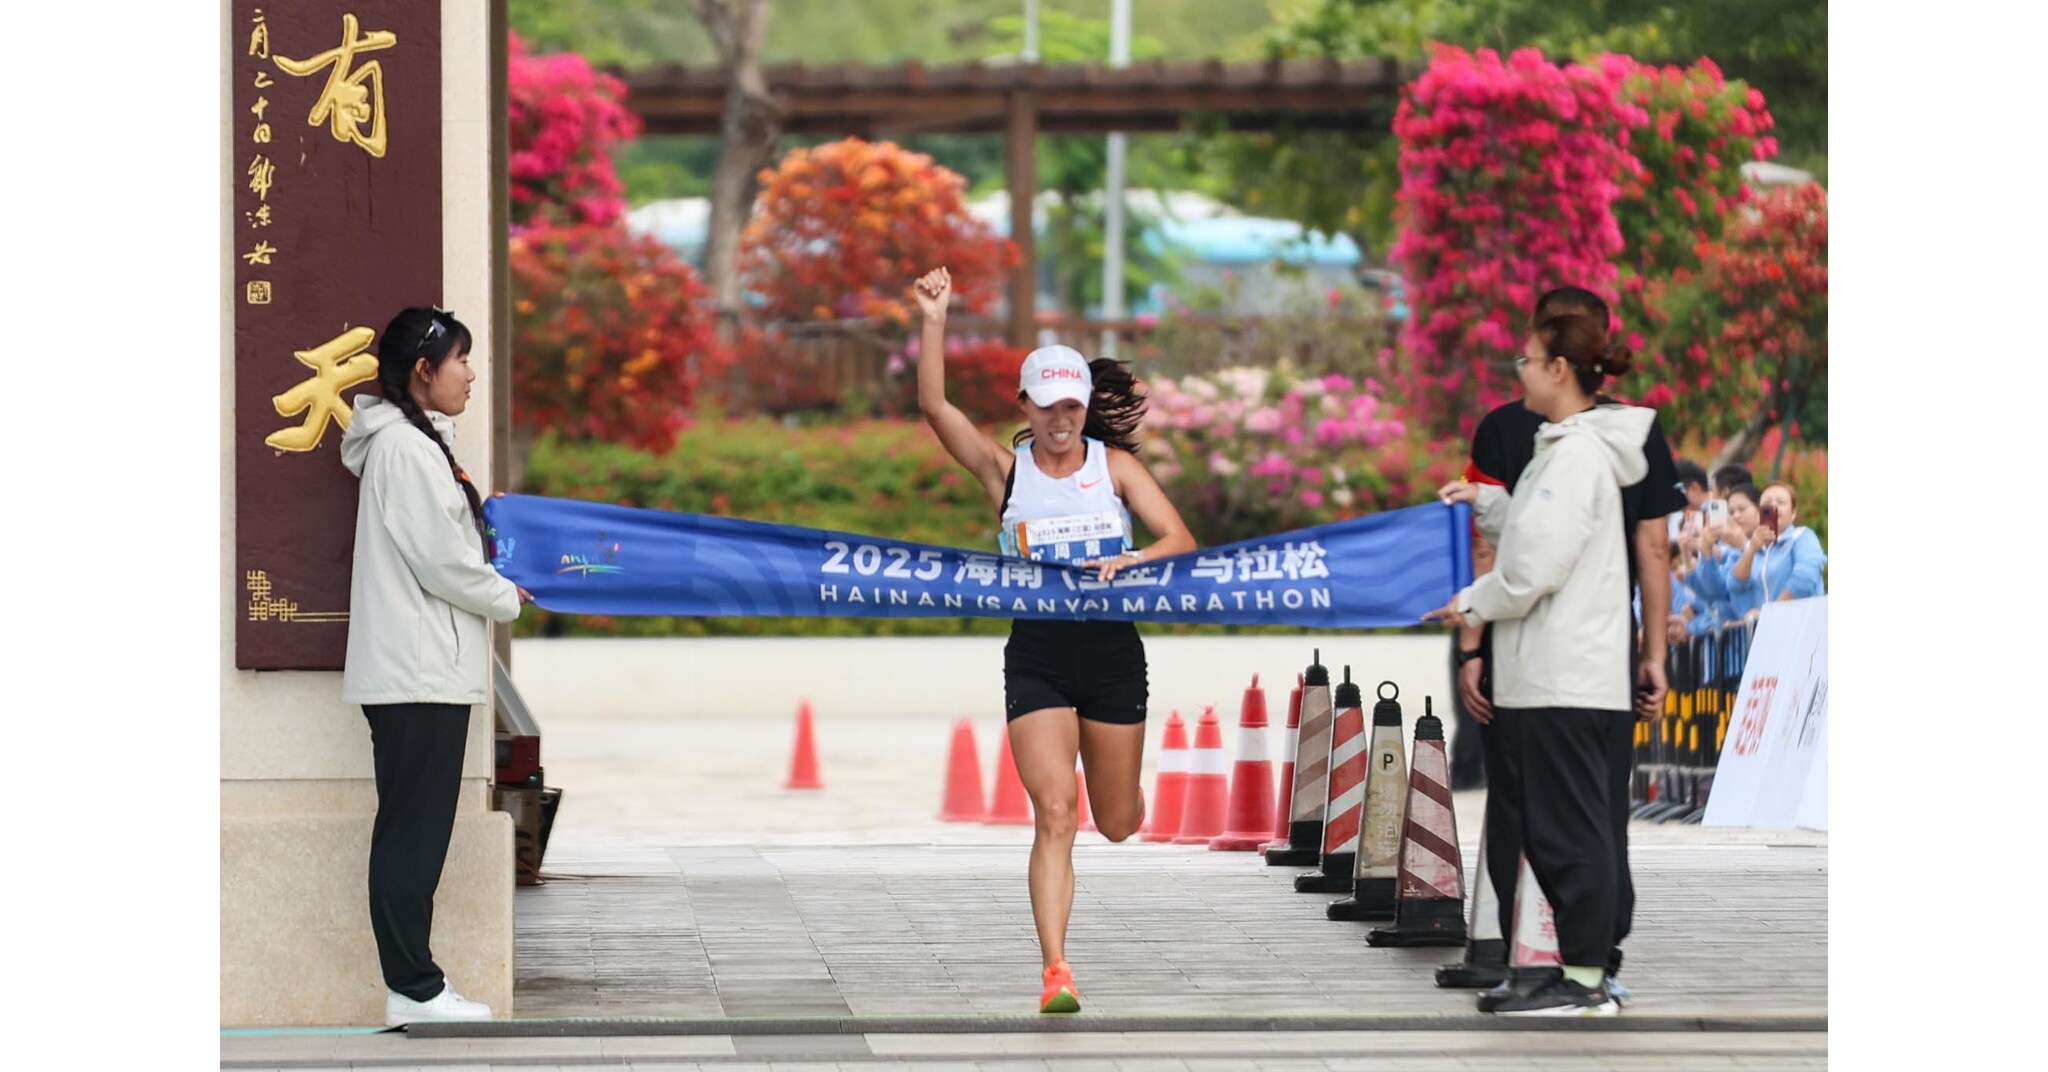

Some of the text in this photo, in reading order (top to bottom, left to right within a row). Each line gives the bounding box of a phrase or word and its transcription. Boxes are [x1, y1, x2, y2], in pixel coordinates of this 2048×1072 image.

[1041, 368, 1083, 380] CHINA
[821, 541, 943, 581] 2025
[820, 584, 962, 608] HAINAN
[1122, 587, 1331, 613] MARATHON
[1383, 753, 1394, 770] P
